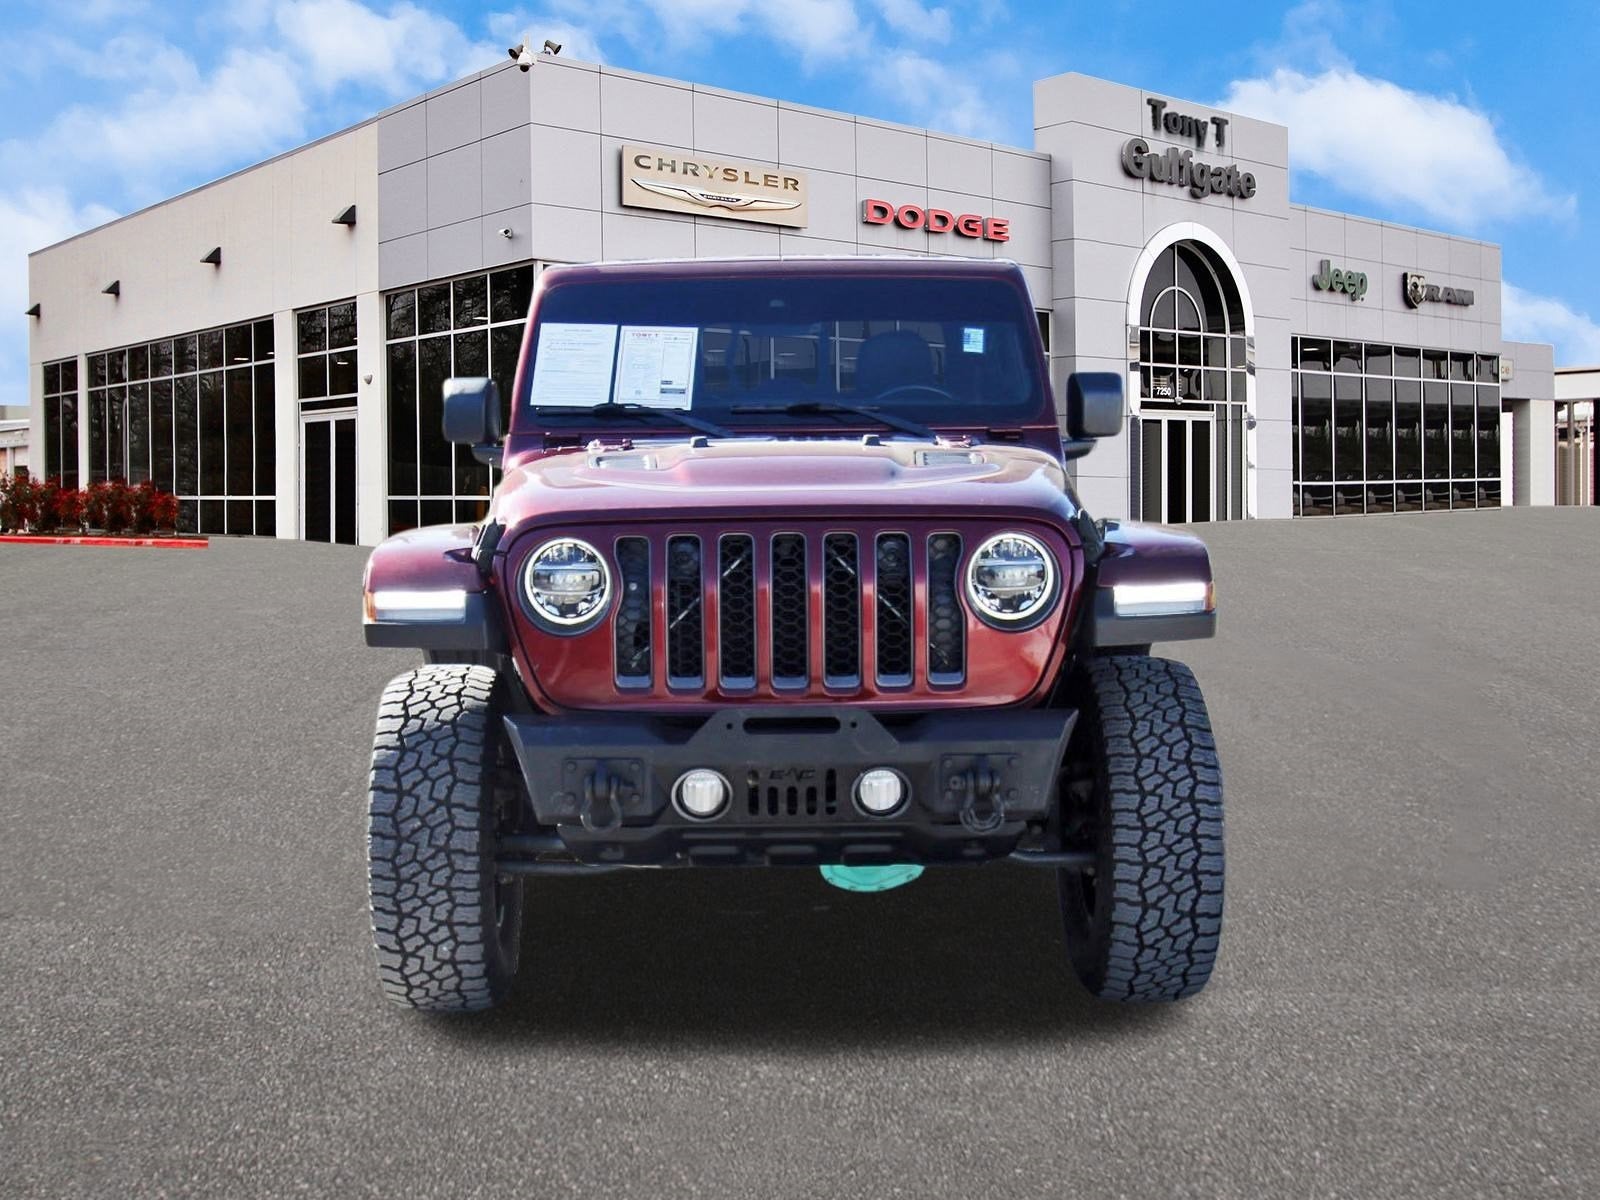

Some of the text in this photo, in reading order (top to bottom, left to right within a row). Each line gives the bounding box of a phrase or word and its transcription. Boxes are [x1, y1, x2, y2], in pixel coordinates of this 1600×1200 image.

[1146, 97, 1230, 148] Tony T
[633, 153, 801, 193] CHRYSLER
[1121, 137, 1257, 199] Gulfgate
[862, 198, 1011, 243] DODGE
[1312, 259, 1368, 302] Jeep
[1425, 284, 1475, 307] RAM
[1156, 386, 1172, 396] 7250
